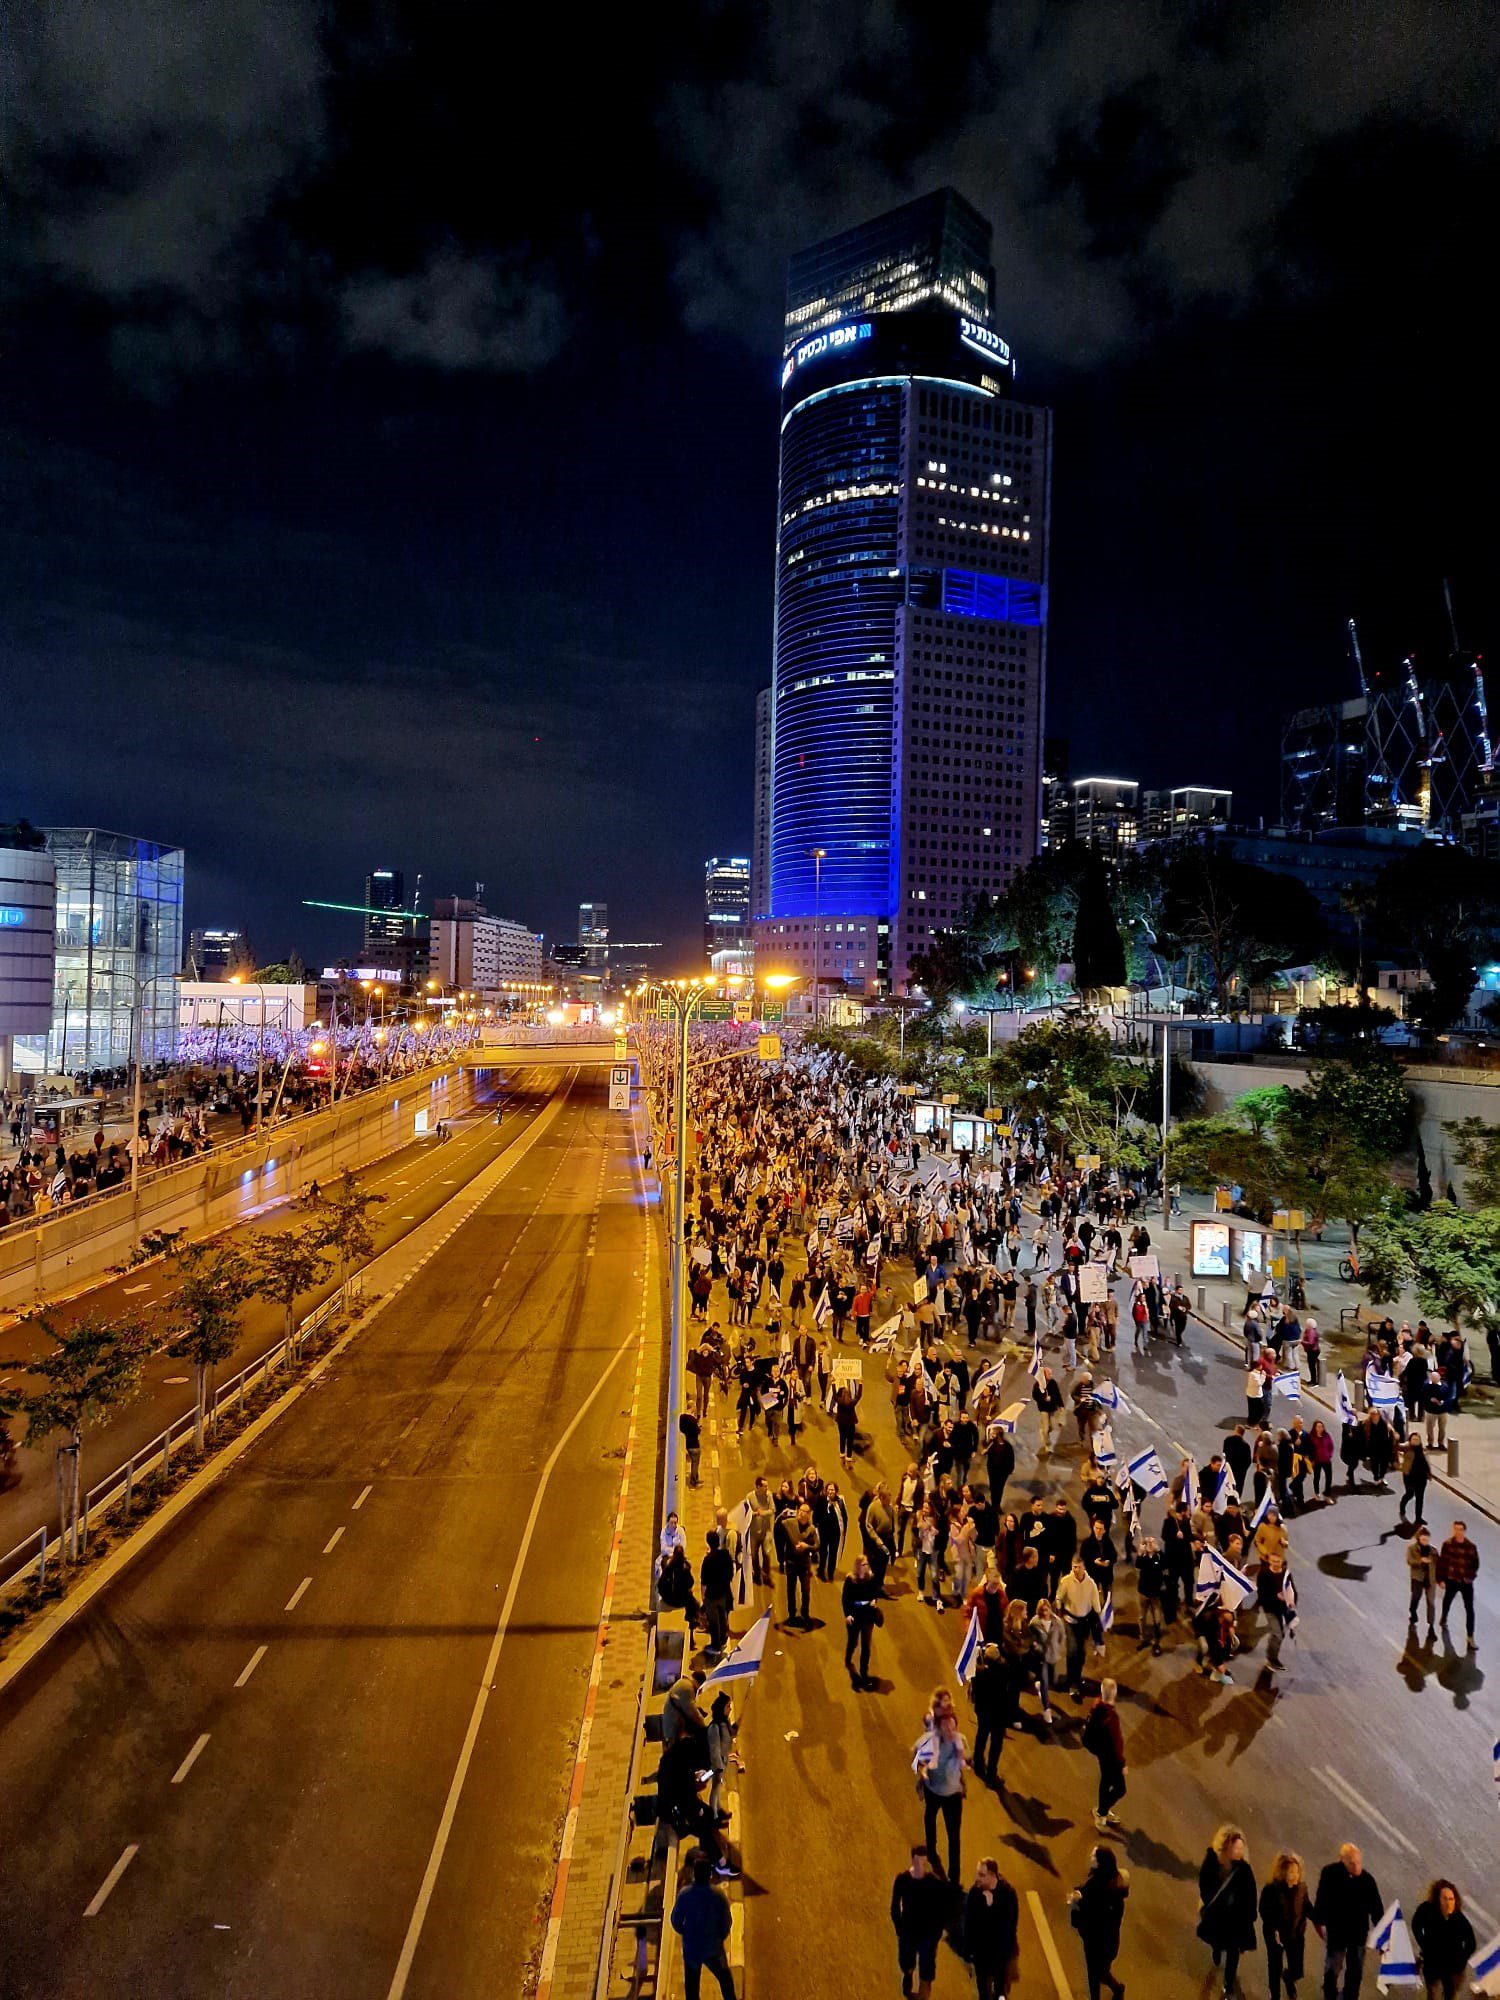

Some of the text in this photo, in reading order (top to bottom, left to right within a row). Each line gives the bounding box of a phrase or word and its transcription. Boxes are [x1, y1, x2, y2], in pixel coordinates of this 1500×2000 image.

[798, 326, 857, 365] אפי נכסים
[961, 318, 1010, 359] מרכנתיל
